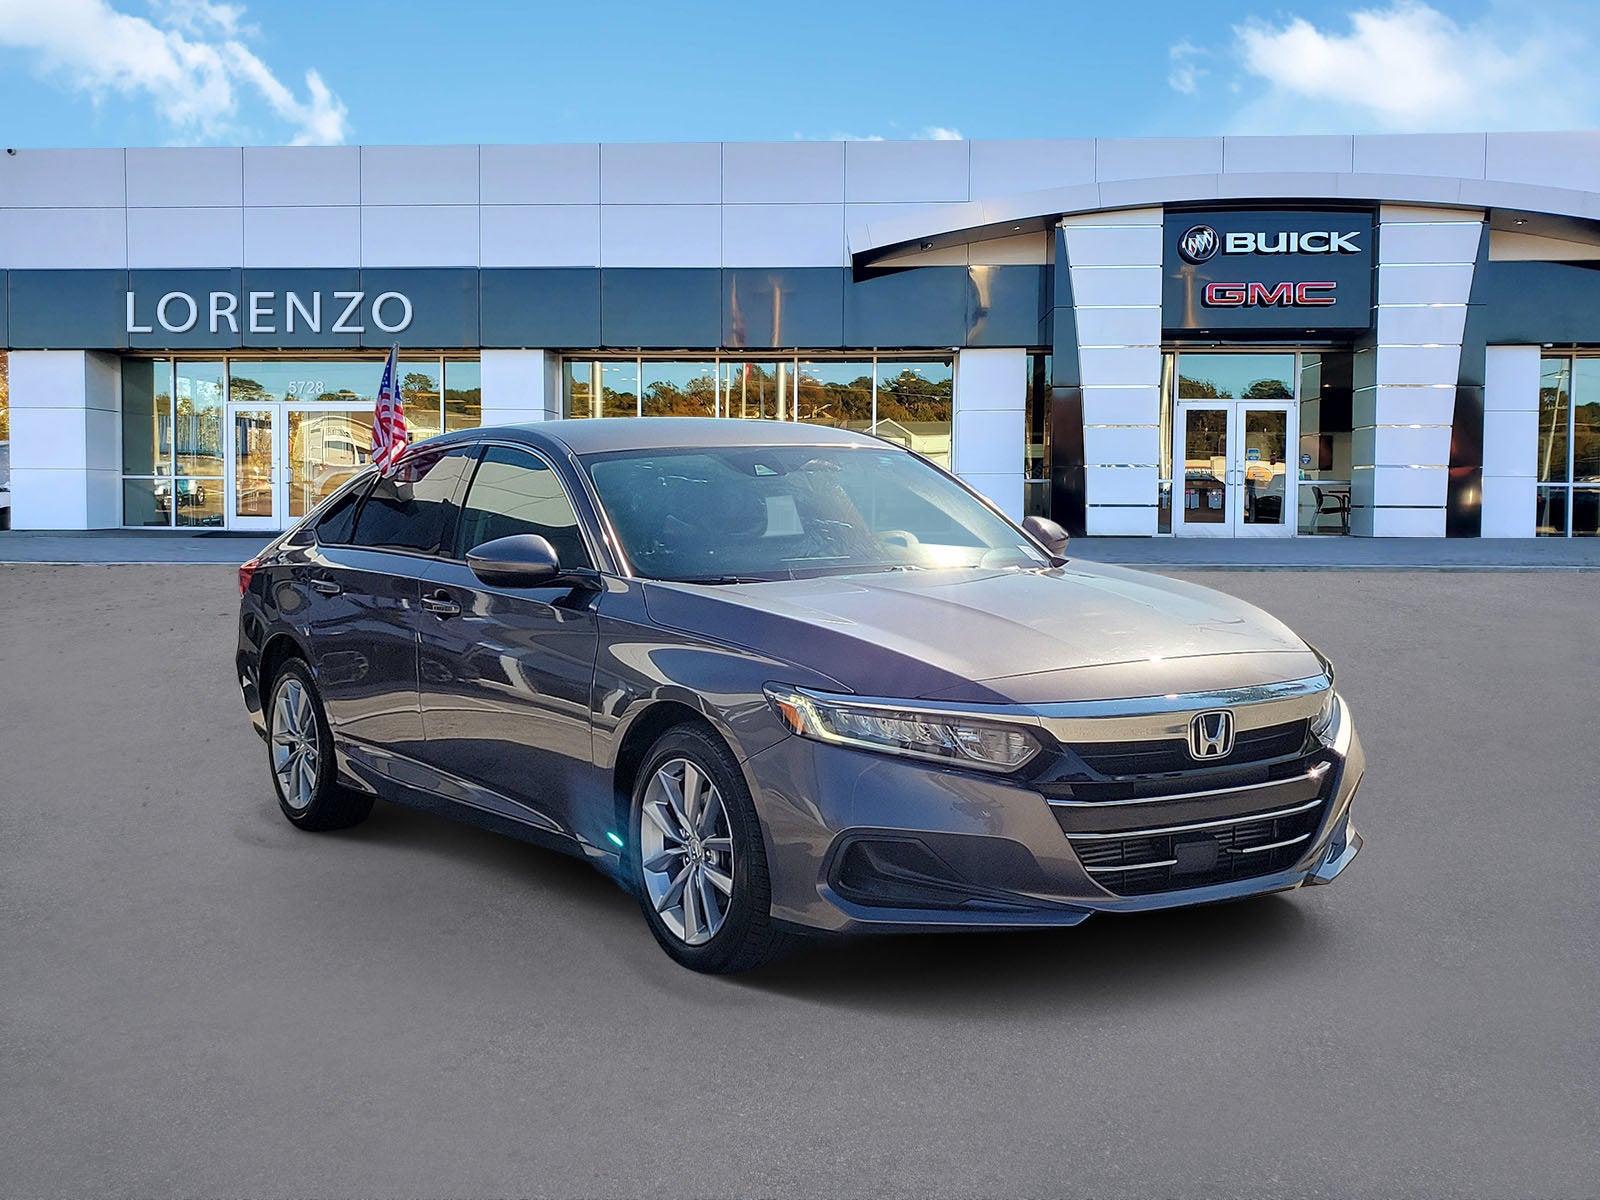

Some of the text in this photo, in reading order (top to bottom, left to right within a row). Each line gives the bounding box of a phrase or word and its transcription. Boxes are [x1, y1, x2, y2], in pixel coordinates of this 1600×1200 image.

[1225, 231, 1362, 253] BUICK
[1205, 282, 1337, 305] GMC
[126, 291, 413, 333] LORENZO
[288, 380, 325, 394] 5728
